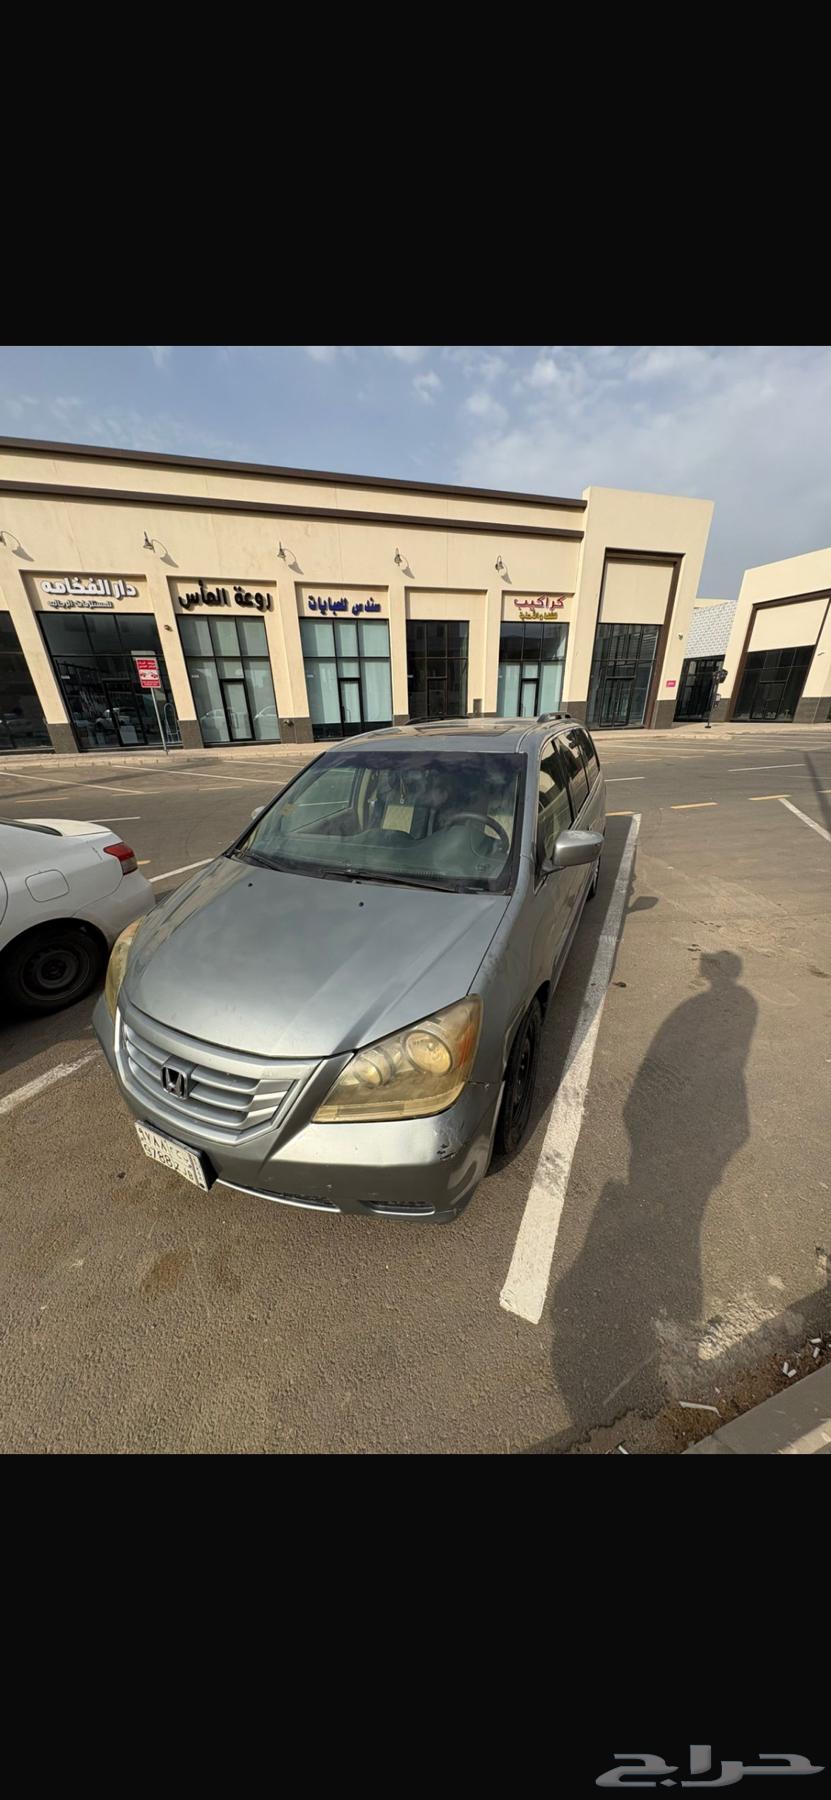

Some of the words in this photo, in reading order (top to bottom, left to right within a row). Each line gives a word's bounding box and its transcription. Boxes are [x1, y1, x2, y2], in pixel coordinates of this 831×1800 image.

[111, 579, 138, 599] دار
[233, 586, 272, 611] روعة
[308, 595, 349, 616] للعبايات
[352, 597, 381, 616] سندس
[514, 592, 567, 612] كراكيب
